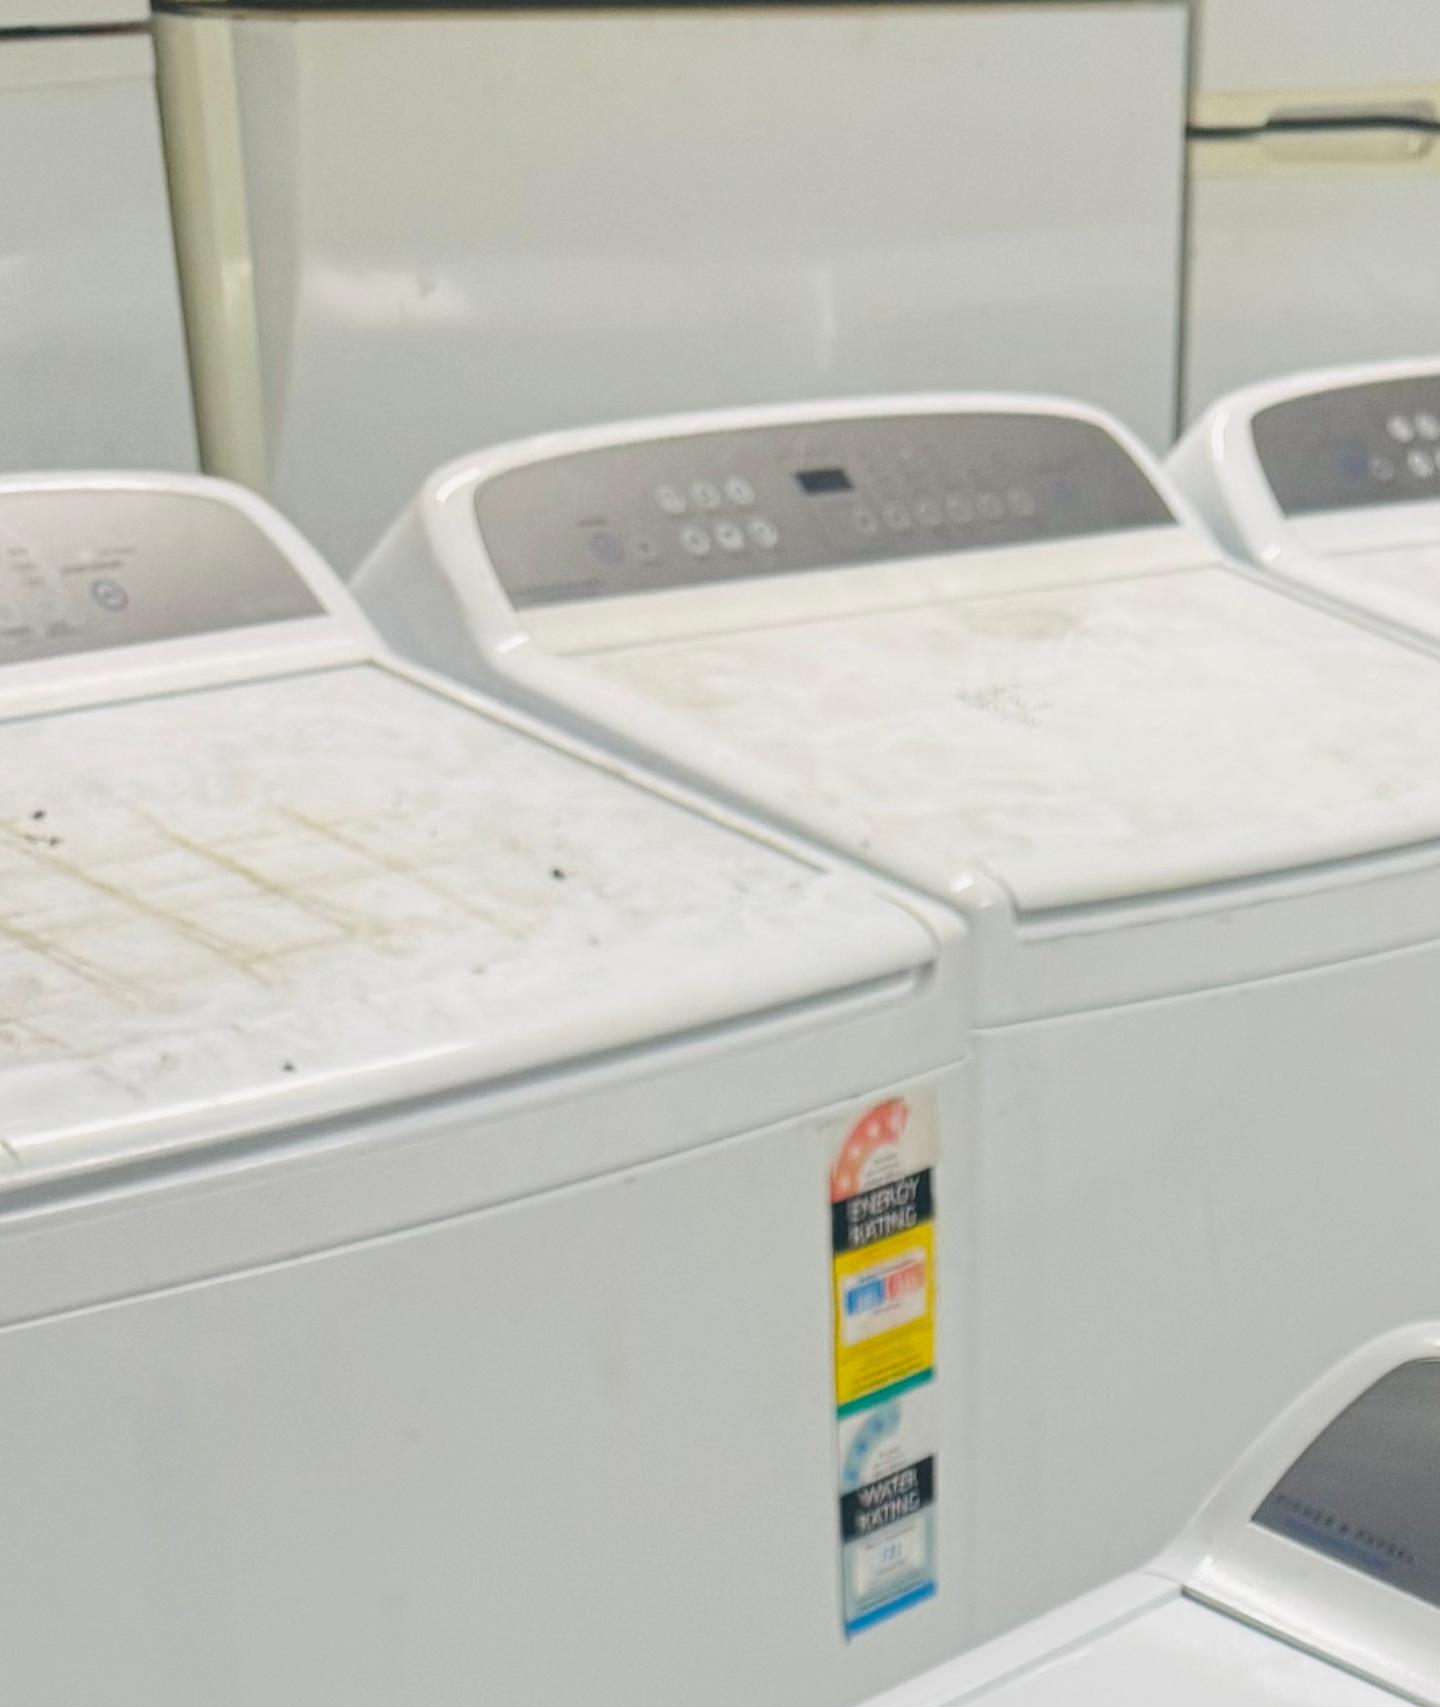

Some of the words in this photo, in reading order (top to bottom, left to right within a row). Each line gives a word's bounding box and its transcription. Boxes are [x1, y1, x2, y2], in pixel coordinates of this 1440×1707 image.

[851, 1175, 920, 1222] ENERGY
[851, 1207, 918, 1247] RATING
[857, 1467, 919, 1508] WATER
[855, 1492, 921, 1531] RATING
